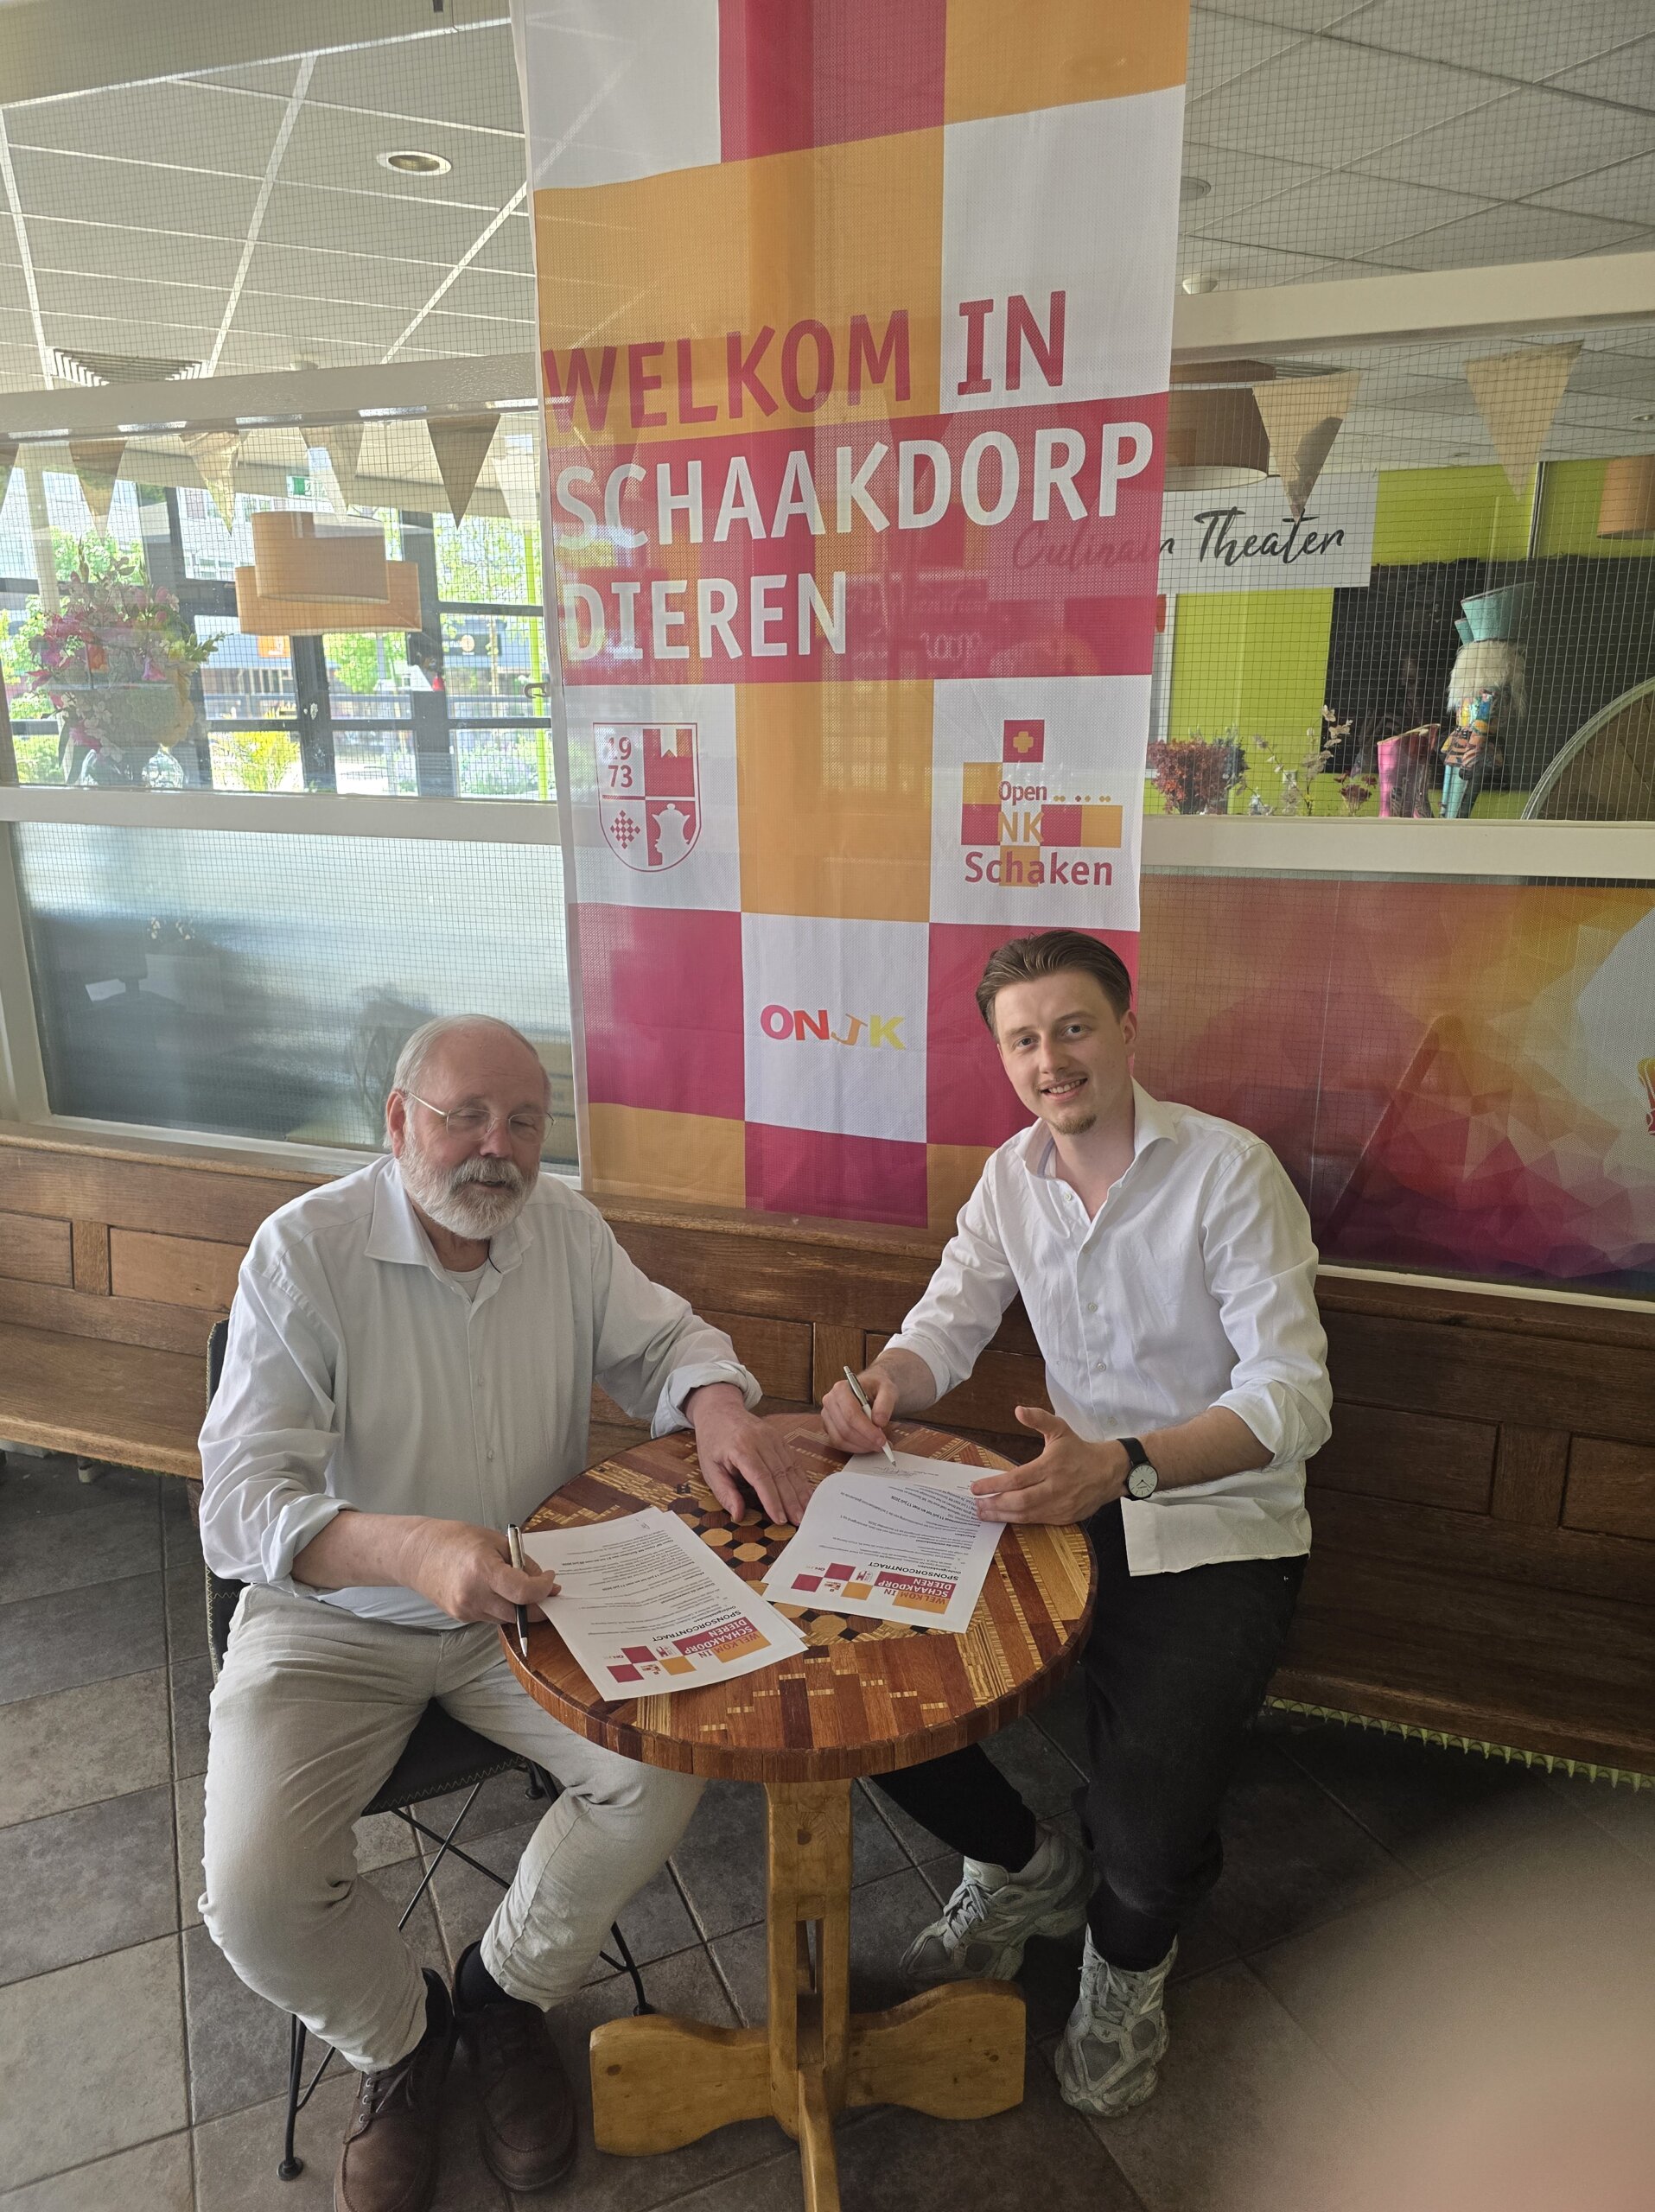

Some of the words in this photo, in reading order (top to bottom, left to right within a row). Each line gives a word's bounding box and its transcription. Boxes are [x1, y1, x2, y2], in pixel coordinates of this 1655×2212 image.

[543, 309, 911, 432] WELKOM
[958, 290, 1066, 397] IN
[556, 422, 1155, 551] SCHAAKDORP
[1194, 506, 1345, 567] Theater
[562, 571, 847, 662] DIEREN
[608, 736, 632, 760] 19
[608, 765, 633, 788] 73
[998, 780, 1047, 805] Open
[997, 811, 1045, 843] NK
[964, 850, 1113, 886] Schaken
[761, 1004, 907, 1051] ONJK
[867, 1561, 958, 1580] SPONSORCONTRACT
[877, 1580, 949, 1597] SCHAAKDORP
[913, 1578, 952, 1589] DIEREN
[899, 1591, 945, 1604] WELKOM
[652, 1609, 741, 1642] SPONSORCONTRACT
[707, 1618, 747, 1637] DIEREN
[684, 1625, 753, 1654] SCHAAKDORP
[713, 1631, 760, 1653] WELKOM
[697, 1649, 712, 1658] IN
